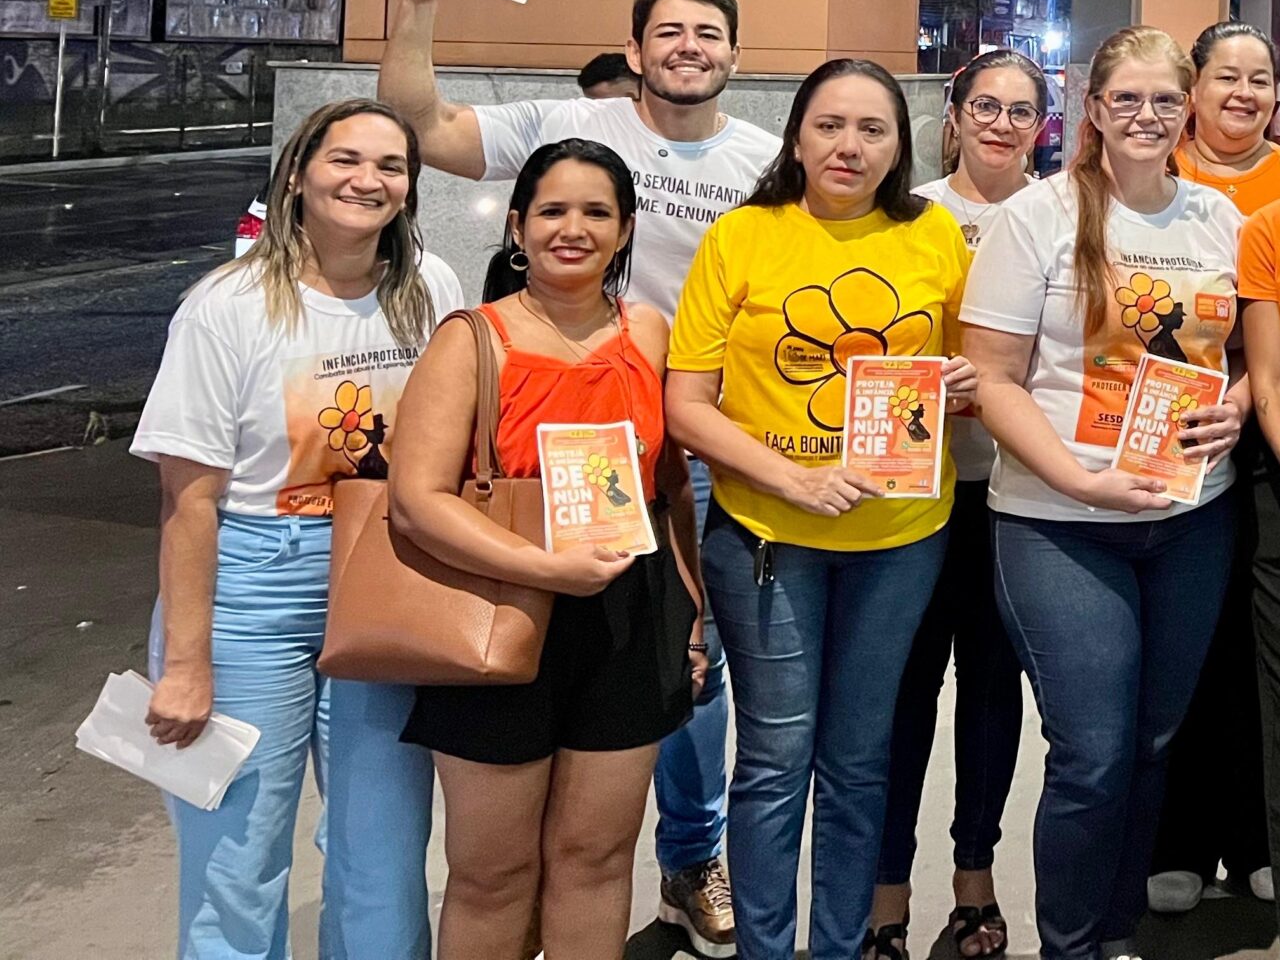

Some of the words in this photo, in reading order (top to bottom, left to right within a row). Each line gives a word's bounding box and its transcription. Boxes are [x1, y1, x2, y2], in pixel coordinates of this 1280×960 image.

[644, 173, 691, 196] SEXUAL
[1120, 253, 1158, 266] INFÂNCIA
[322, 353, 367, 371] INFÂNCIA
[855, 380, 896, 388] PROTEJA
[1144, 378, 1180, 394] PROTEJA
[854, 396, 890, 420] DE
[1137, 394, 1171, 421] DE
[852, 419, 894, 435] NUN
[1133, 417, 1170, 437] NUN
[765, 431, 796, 454] FAÇA
[800, 435, 843, 455] BONIT
[851, 436, 888, 457] CIE
[1128, 432, 1162, 456] CIE
[550, 463, 586, 489] DE
[553, 487, 594, 506] NUN
[554, 503, 594, 527] CIE
